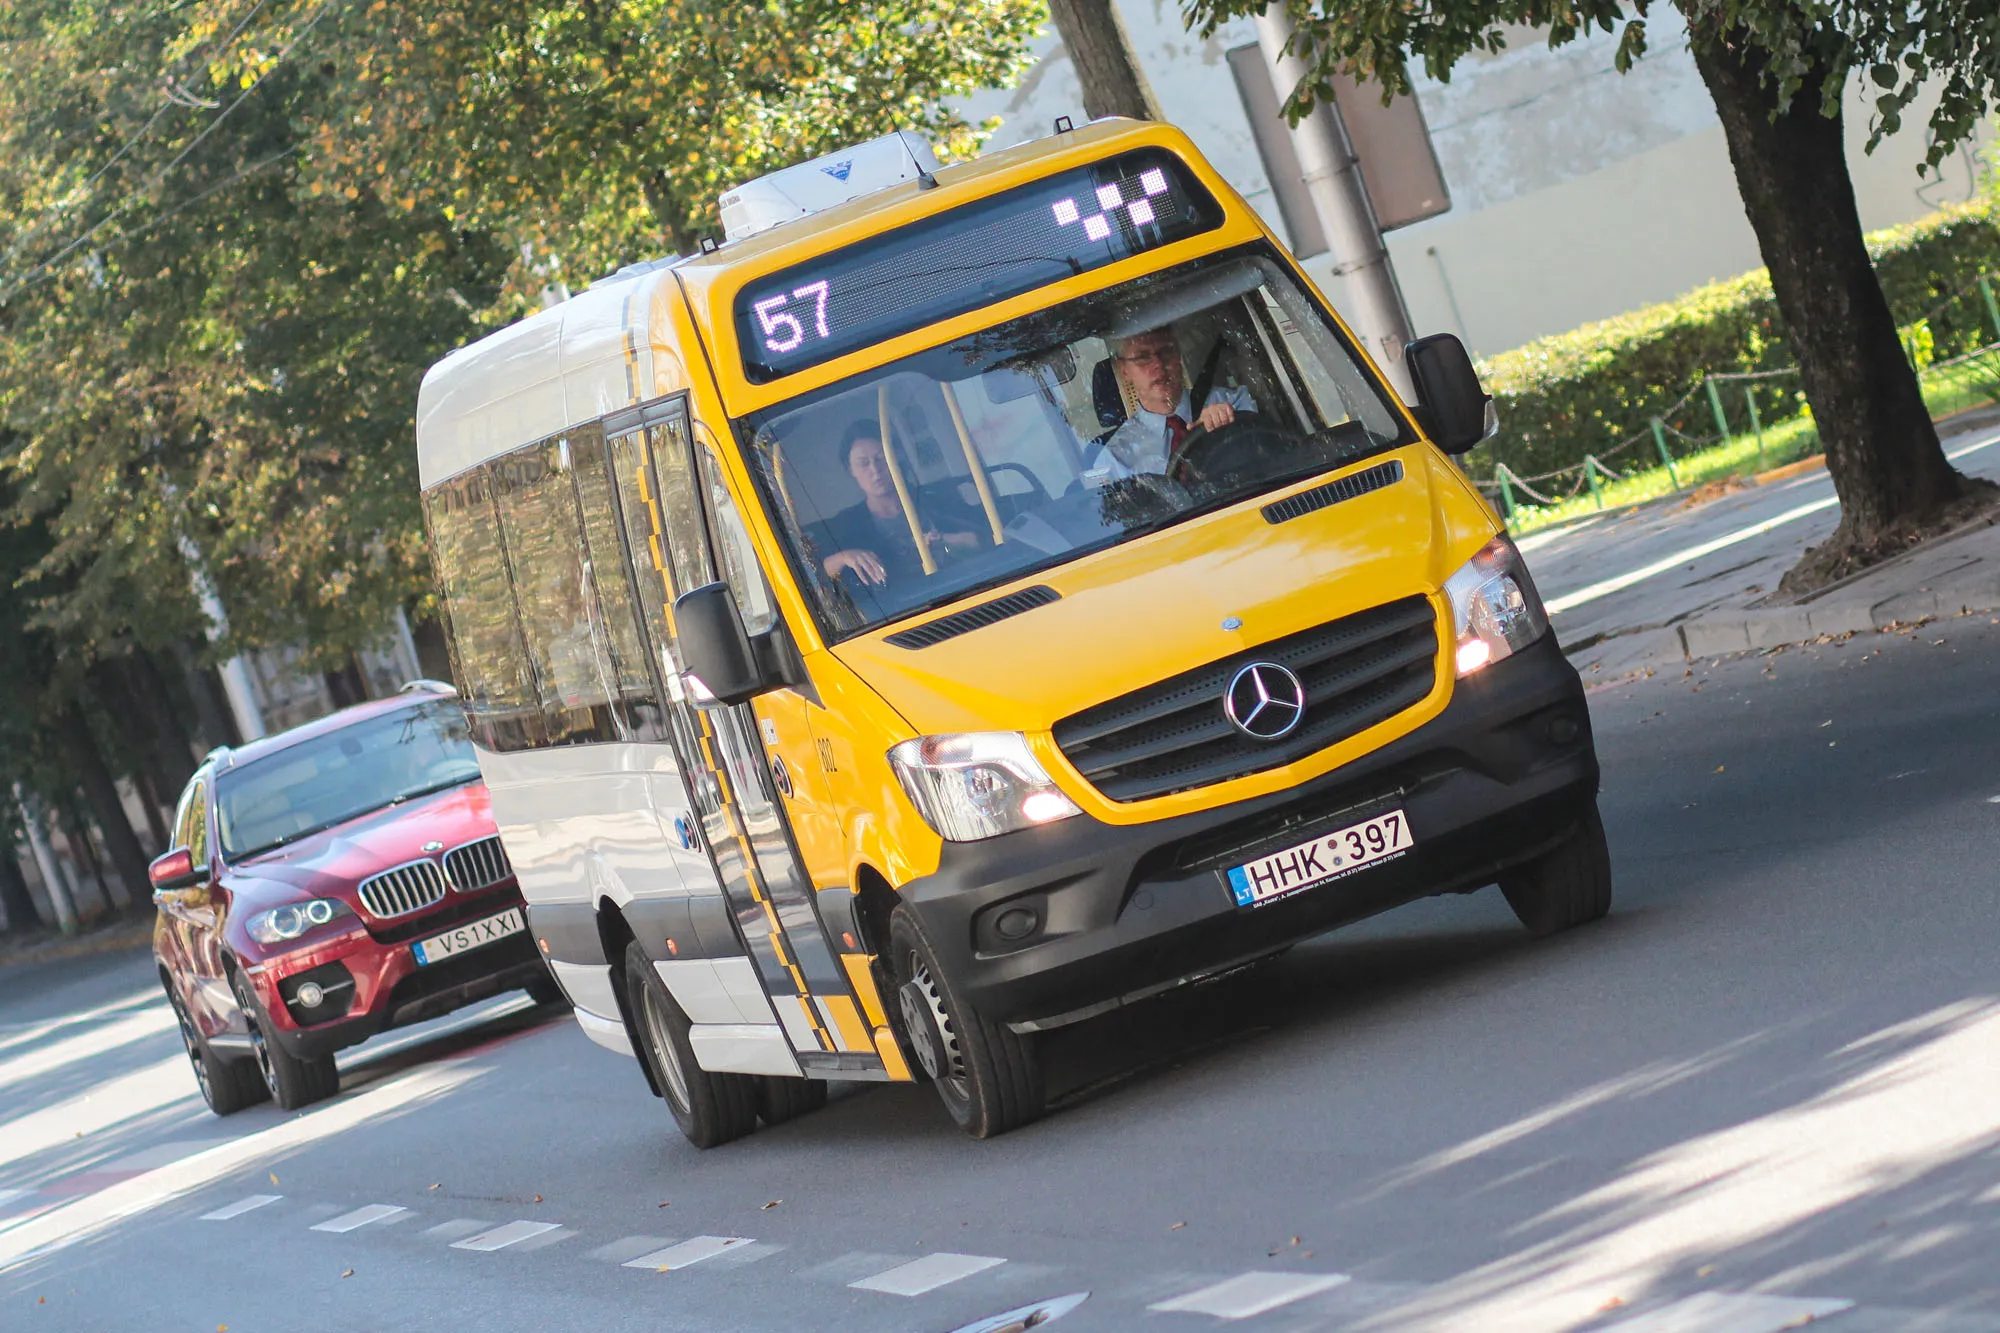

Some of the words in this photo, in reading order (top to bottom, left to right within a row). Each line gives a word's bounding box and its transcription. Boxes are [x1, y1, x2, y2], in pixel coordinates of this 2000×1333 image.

[754, 280, 829, 353] 57
[1250, 843, 1327, 895] HHK
[1345, 815, 1400, 860] 397
[1236, 888, 1251, 901] LT
[439, 912, 517, 953] VS1XXI
